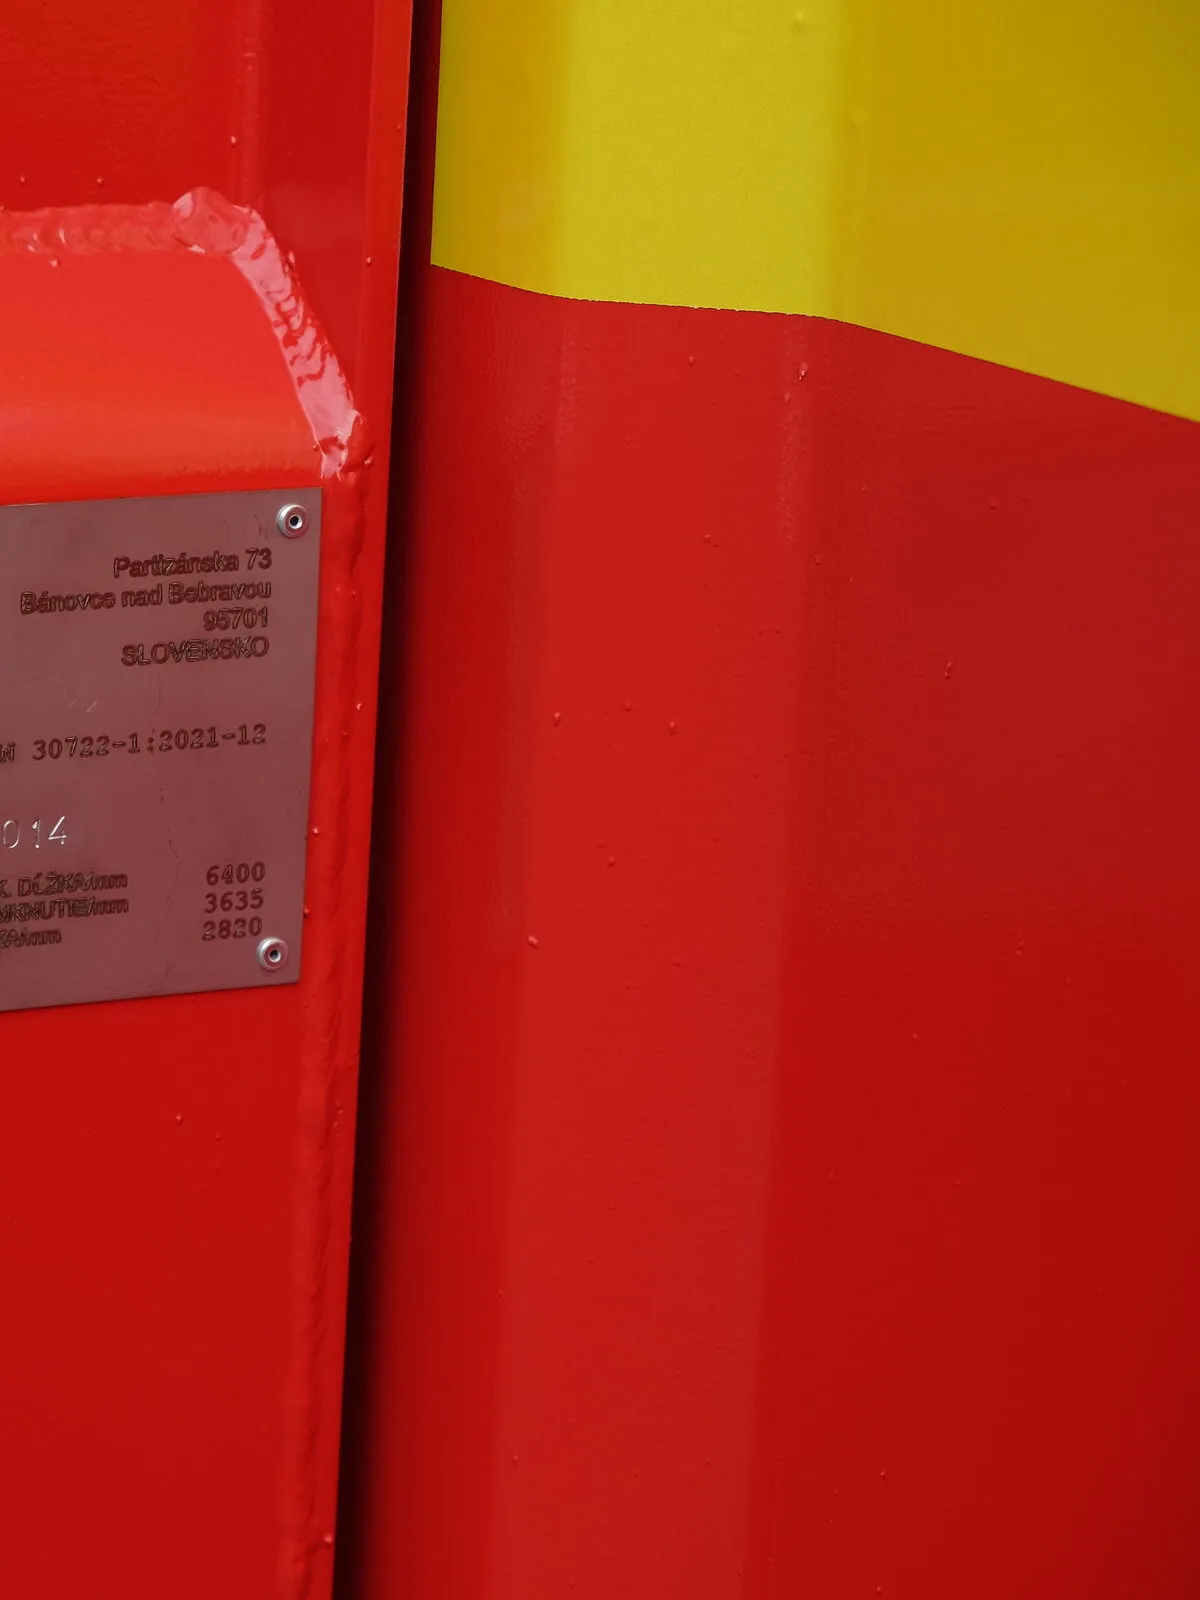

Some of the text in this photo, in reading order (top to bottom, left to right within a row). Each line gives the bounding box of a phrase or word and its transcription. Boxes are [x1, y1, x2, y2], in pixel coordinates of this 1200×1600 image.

[113, 547, 273, 579] Partizánska 73
[20, 579, 272, 615] Bánovce nad Bebravou
[203, 606, 268, 632] 95701
[121, 636, 270, 667] SLOVENSKO
[32, 723, 266, 761] 30722-1:2021-12
[205, 861, 266, 887] 6400
[204, 888, 264, 914] 3635
[201, 916, 263, 942] 2820
